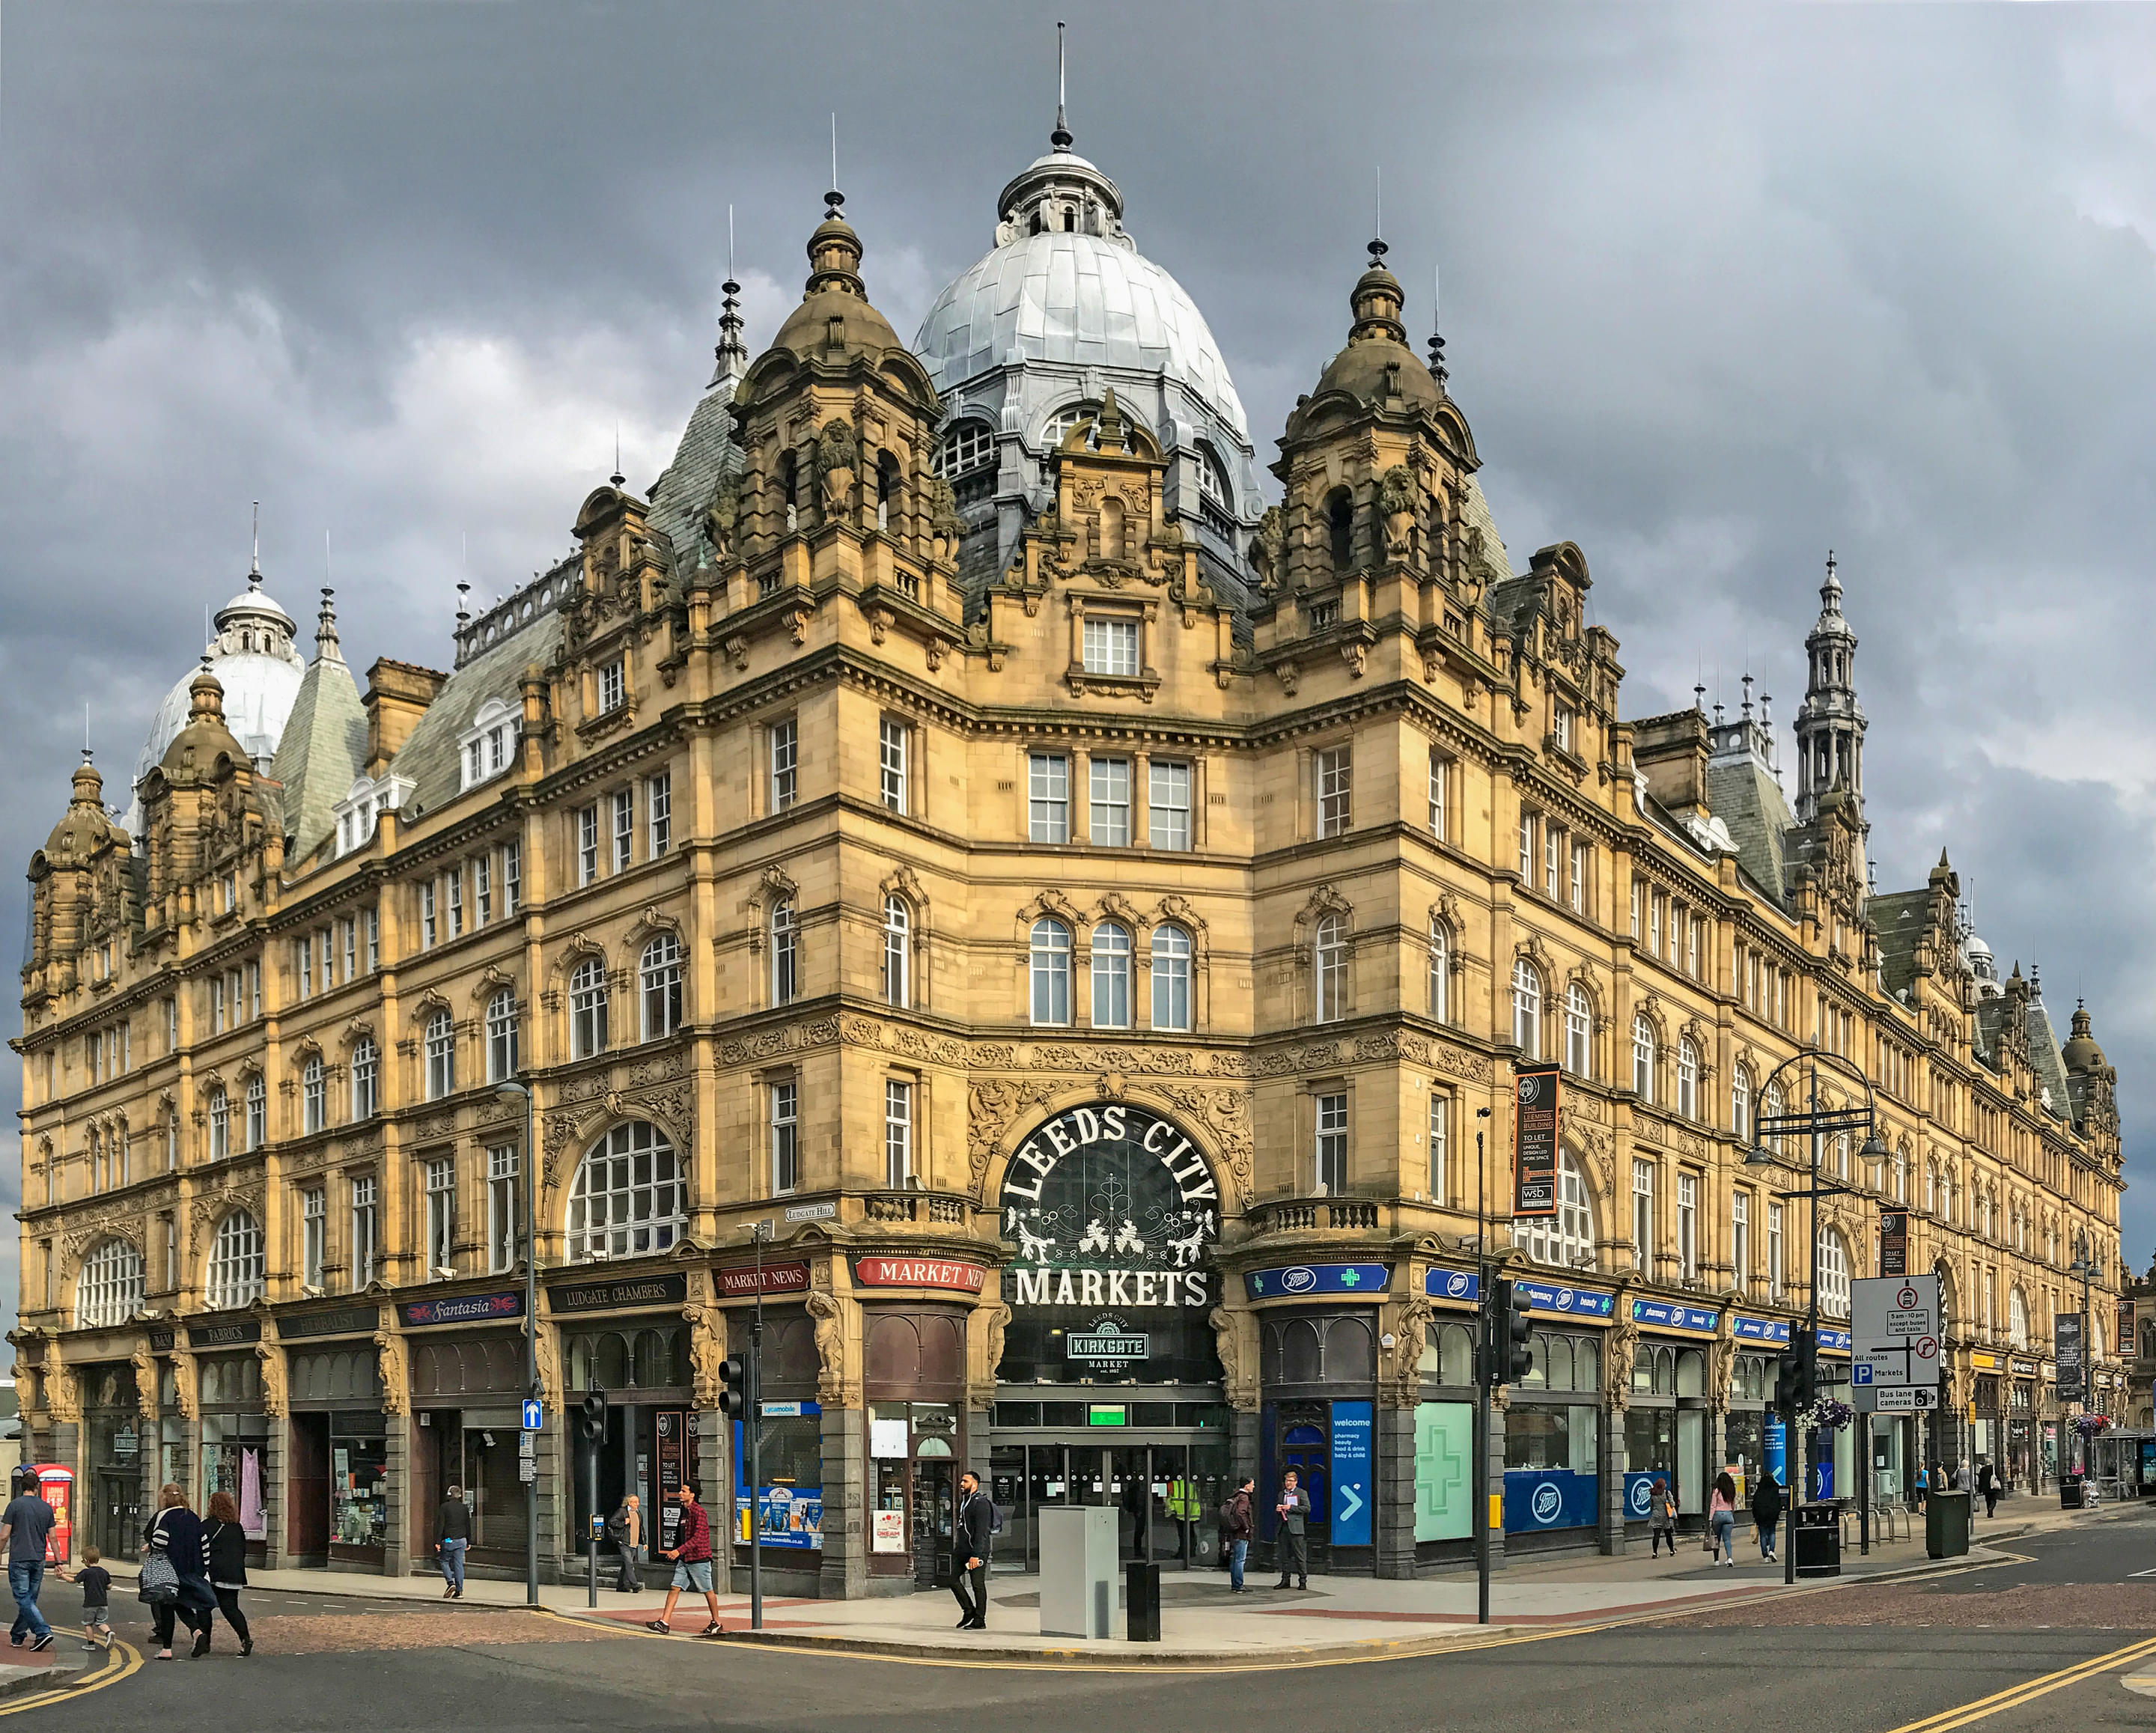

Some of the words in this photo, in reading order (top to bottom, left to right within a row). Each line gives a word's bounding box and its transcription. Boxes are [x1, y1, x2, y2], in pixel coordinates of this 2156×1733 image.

[1523, 1112, 1552, 1121] LEEMING
[1004, 1106, 1127, 1201] LEEDS
[1144, 1121, 1217, 1202] CITY
[1523, 1187, 1544, 1199] wsb
[789, 1210, 816, 1219] LUDGATE
[817, 1207, 831, 1215] HILL
[772, 1269, 803, 1285] NEWS
[880, 1262, 962, 1284] MARKET
[1288, 1272, 1310, 1287] Boots
[566, 1289, 609, 1306] LUDGATE
[612, 1284, 667, 1301] CHAMBERS
[1015, 1269, 1208, 1306] MARKETS
[432, 1300, 490, 1322] Fantasia
[1580, 1297, 1598, 1309] beauty
[1088, 1312, 1113, 1328] LEEDS
[1114, 1313, 1129, 1328] CITY
[1645, 1308, 1667, 1320] pharmacy
[207, 1326, 244, 1342] FABRICS
[1073, 1339, 1143, 1353] KIRKGATE
[1088, 1360, 1129, 1368] MARKET
[1858, 1366, 1870, 1383] P
[764, 1405, 796, 1413] Lycamobile
[1537, 1492, 1557, 1513] Boots
